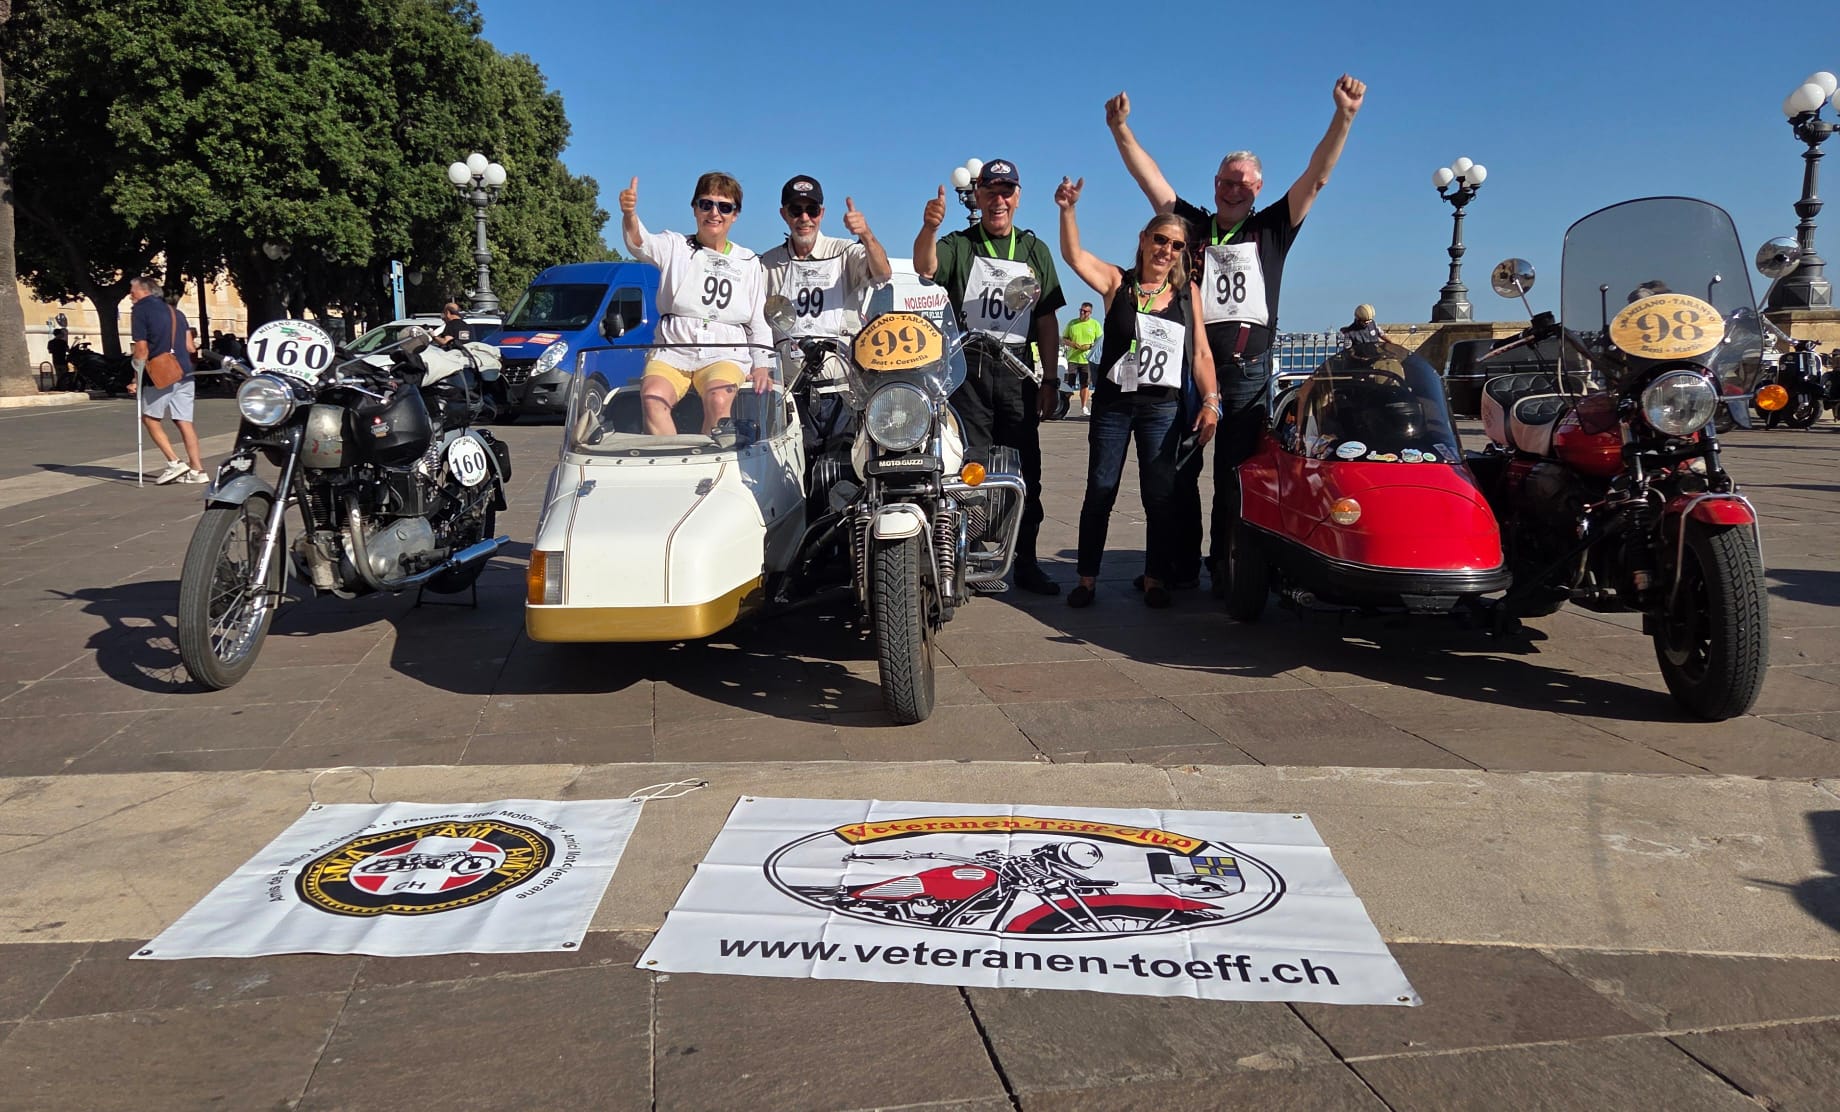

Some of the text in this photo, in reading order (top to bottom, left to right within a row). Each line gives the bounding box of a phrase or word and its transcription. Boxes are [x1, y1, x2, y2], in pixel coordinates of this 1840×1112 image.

[701, 276, 732, 310] 99
[796, 287, 824, 318] 99
[1216, 271, 1246, 305] 98
[1628, 299, 1666, 317] MILANO
[258, 321, 291, 334] MILANO
[297, 322, 330, 345] TARANTO
[865, 316, 895, 336] MILANO
[901, 315, 938, 338] TARANTO
[871, 326, 926, 357] 99
[1637, 310, 1704, 343] 98
[254, 338, 328, 369] 160
[1137, 345, 1168, 383] 98
[452, 451, 484, 477] 160
[392, 813, 460, 827] Freunde
[463, 810, 498, 819] alter
[515, 867, 569, 899] Veterane
[720, 939, 1340, 985] www.veteranen-toeff.ch
